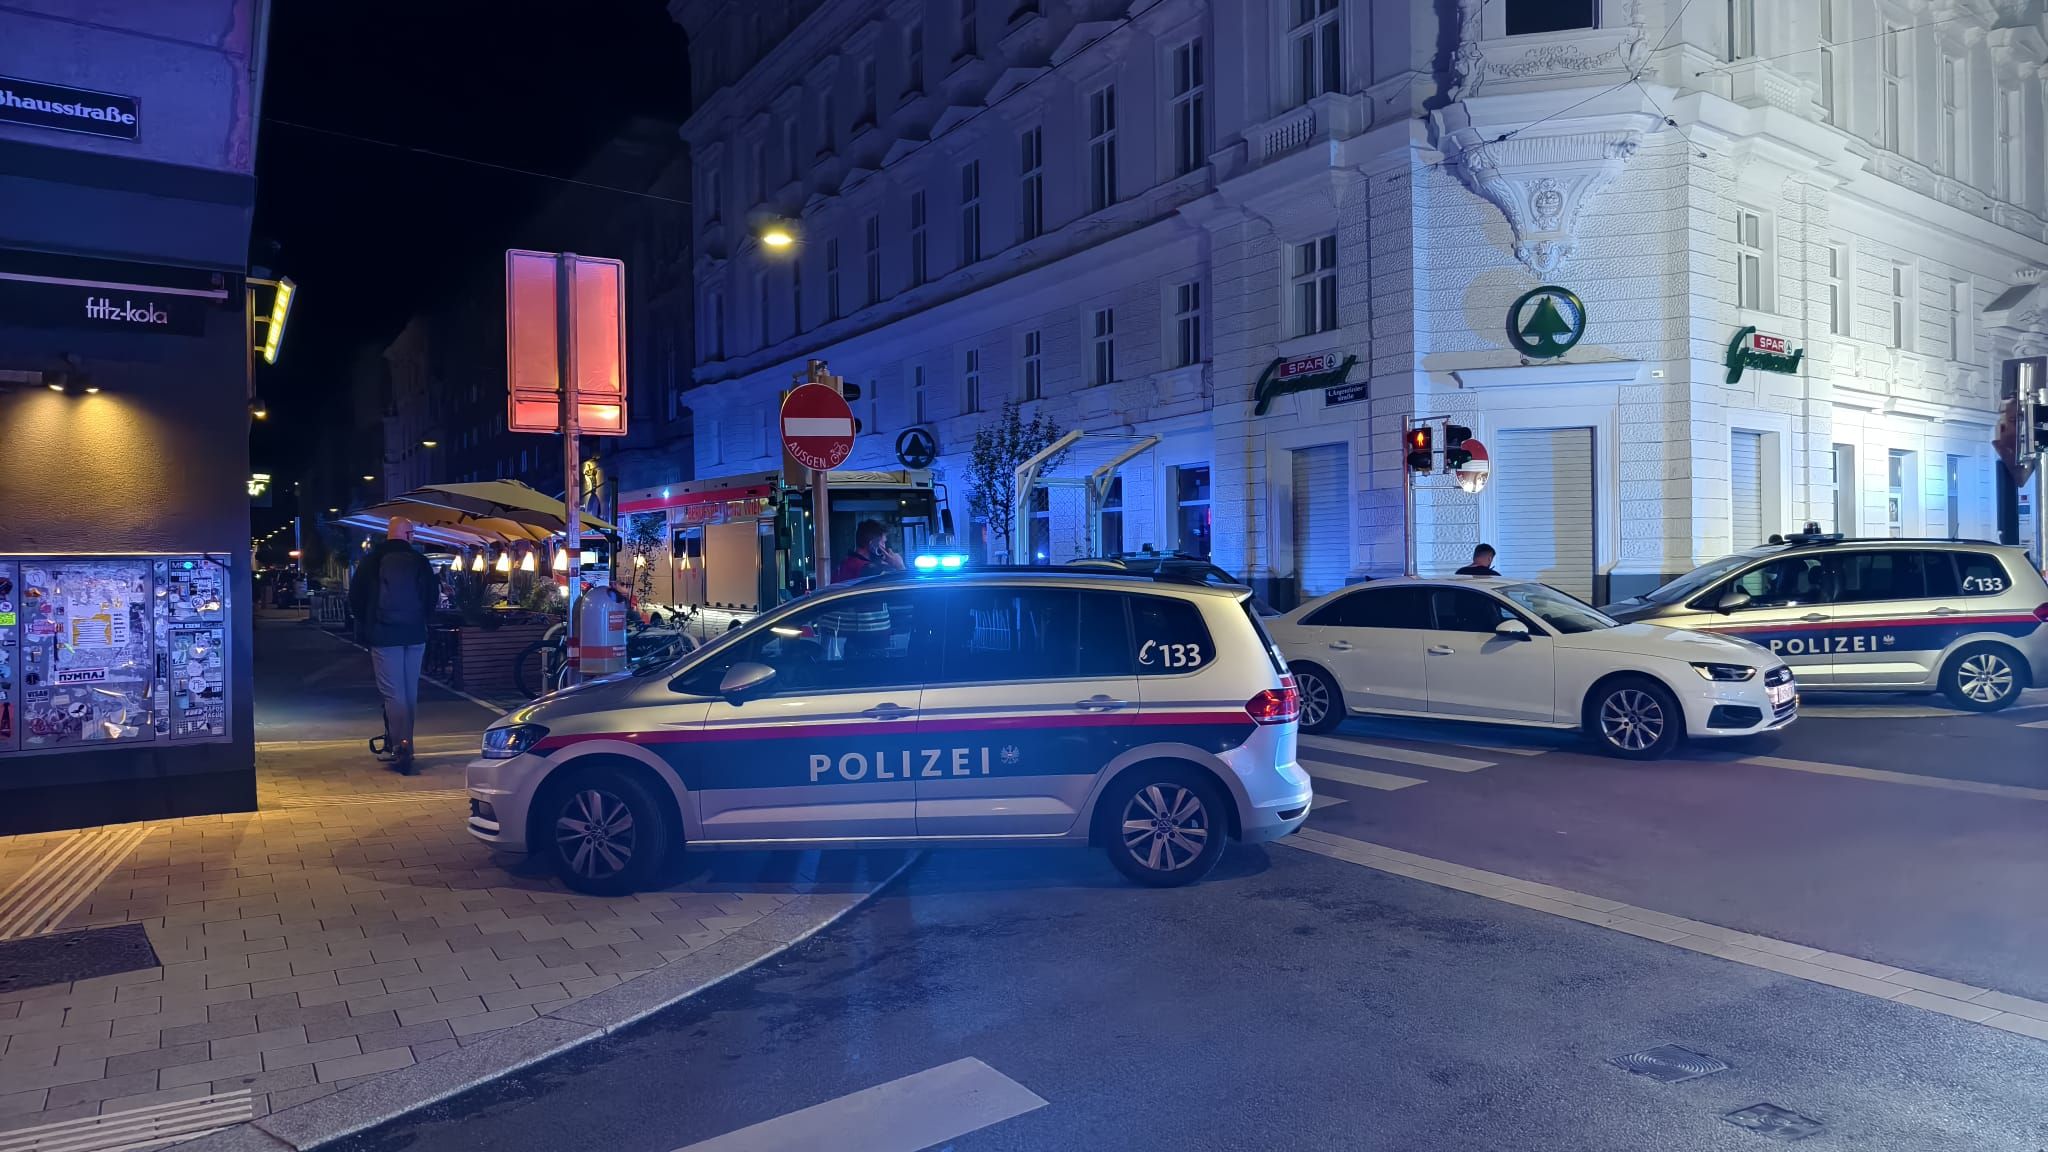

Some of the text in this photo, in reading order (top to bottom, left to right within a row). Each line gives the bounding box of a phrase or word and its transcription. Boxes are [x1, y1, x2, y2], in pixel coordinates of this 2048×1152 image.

[1759, 337, 1785, 352] SPAR
[1288, 358, 1324, 374] SPAR
[1975, 577, 2003, 591] 133
[1769, 635, 1877, 655] POLIZEI
[1159, 643, 1201, 667] 133
[809, 746, 990, 782] POLIZEI
